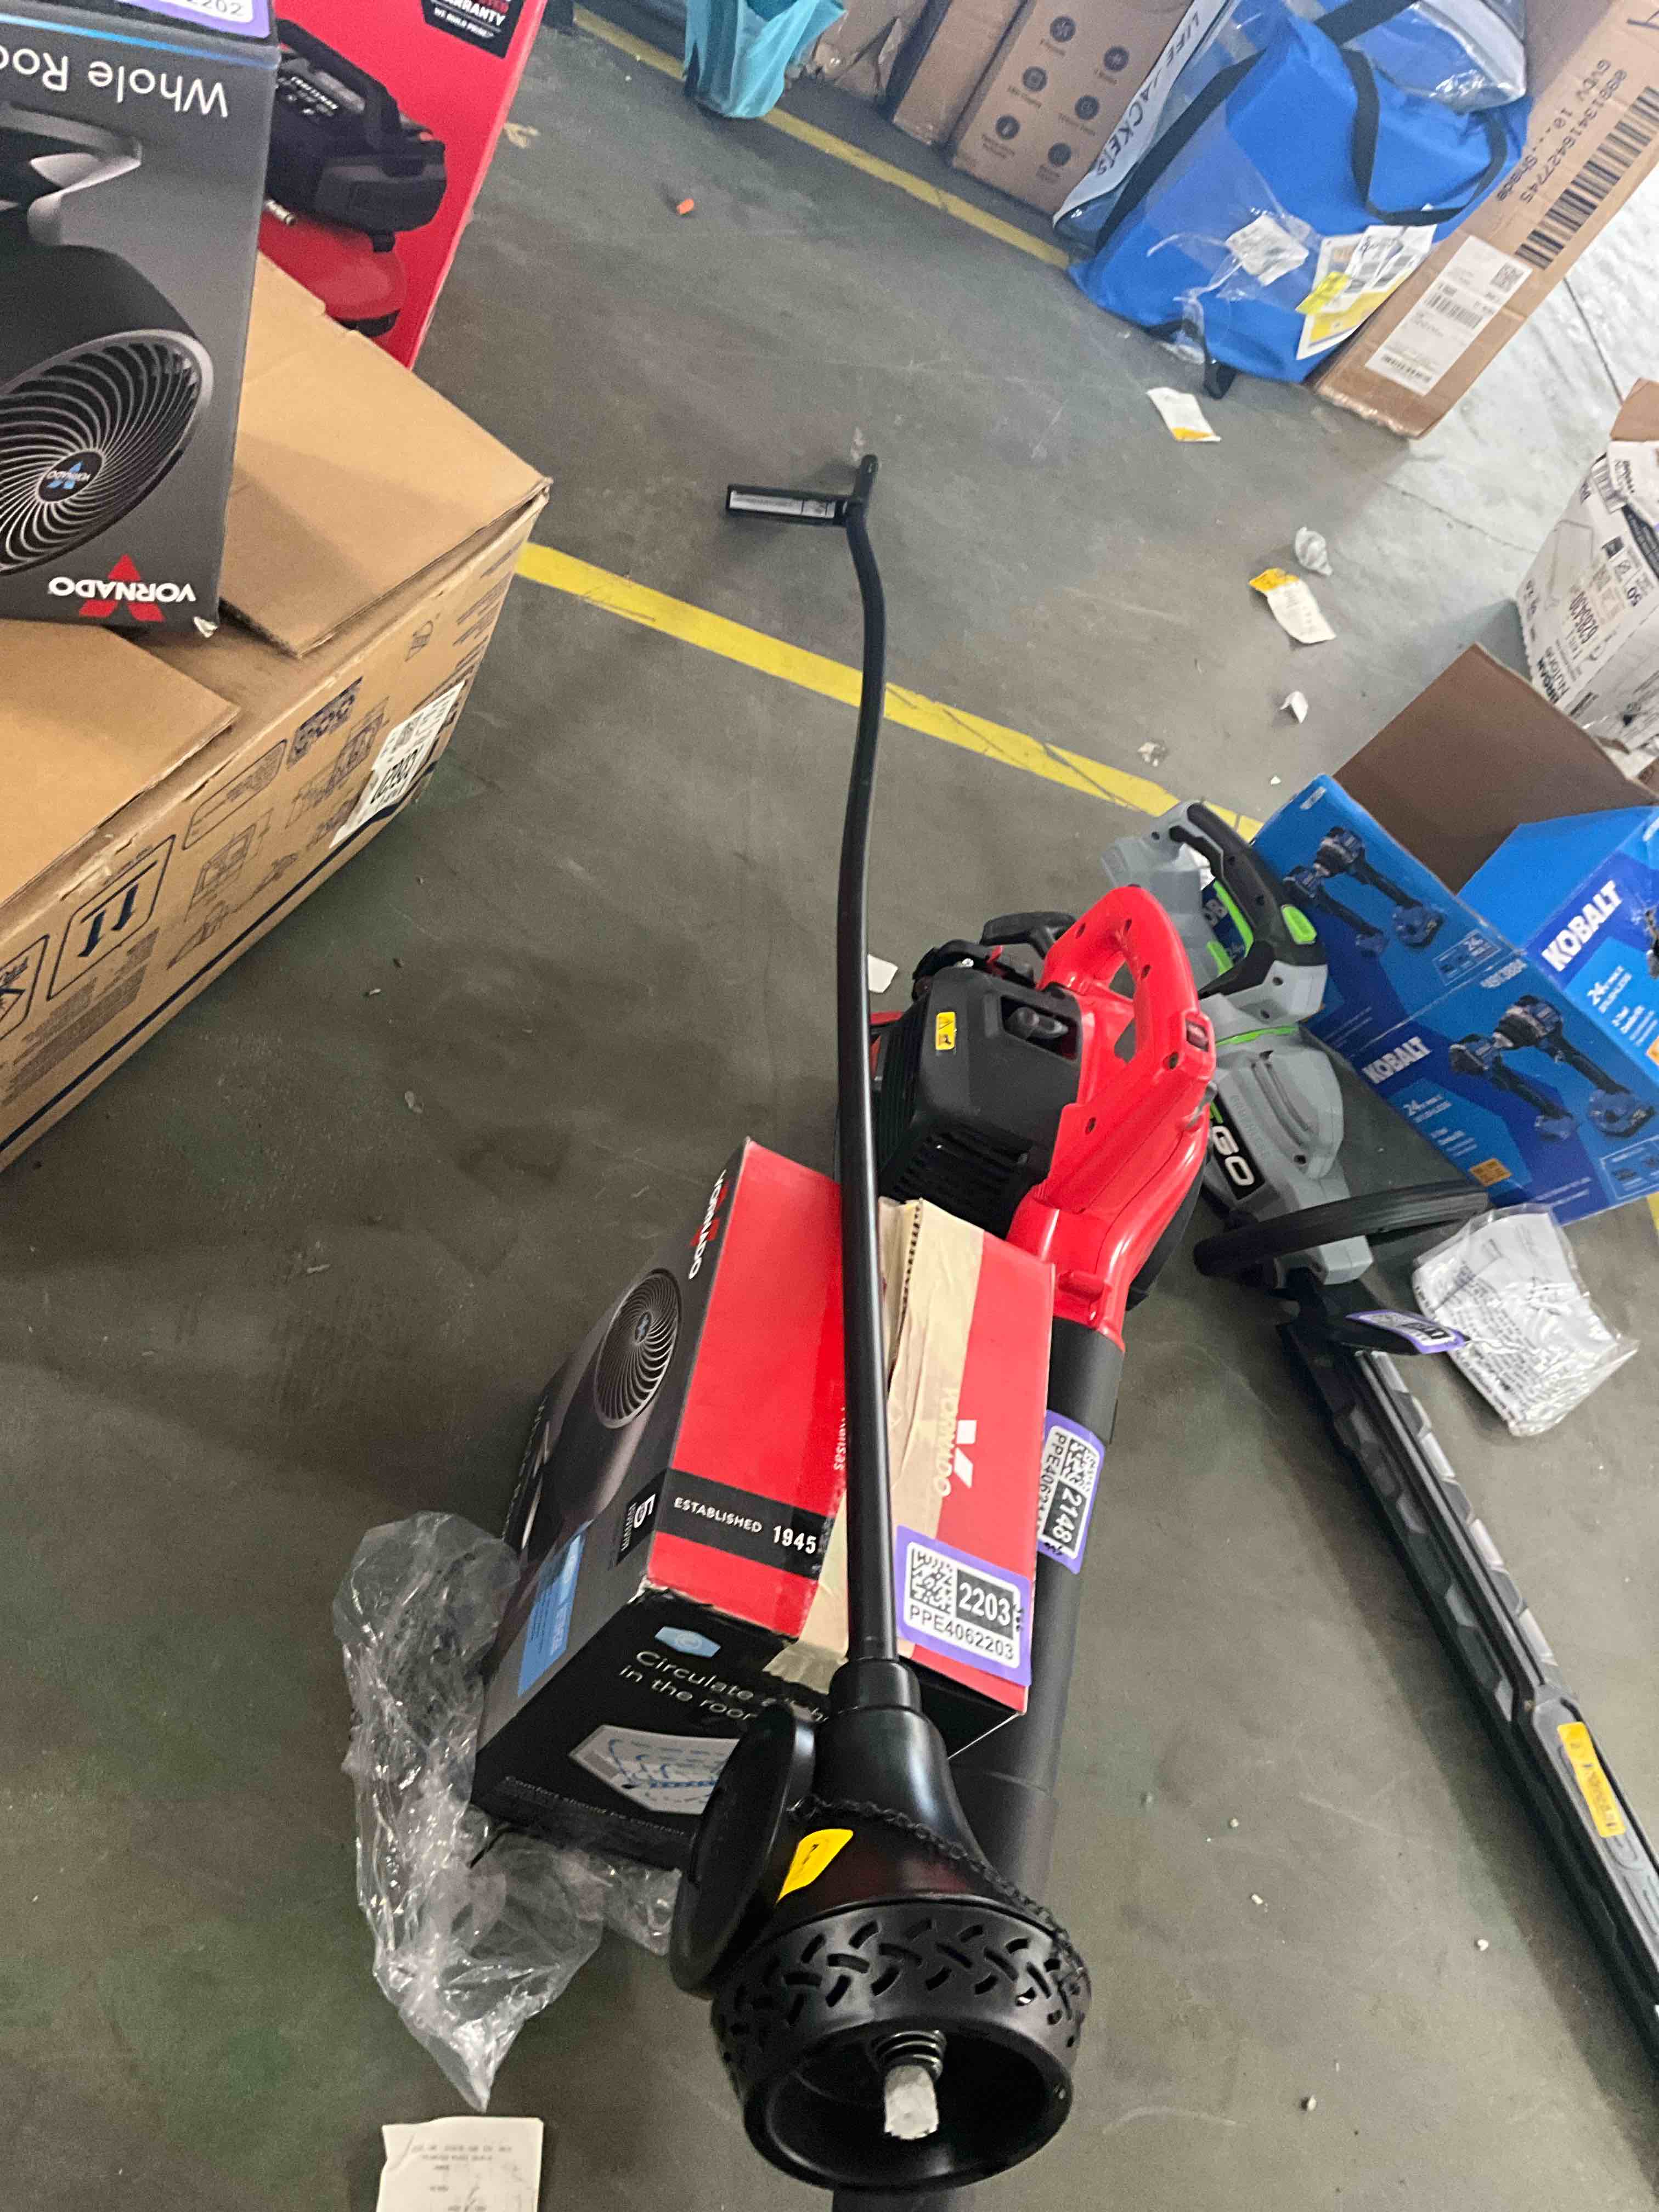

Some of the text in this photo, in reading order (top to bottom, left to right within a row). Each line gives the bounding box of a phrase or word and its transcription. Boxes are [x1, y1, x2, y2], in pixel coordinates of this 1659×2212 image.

[1165, 11, 1200, 66] LIFE
[0, 47, 229, 118] Whole Ro
[1096, 70, 1164, 176] JACKETS
[48, 577, 196, 602] VORNADO
[1541, 879, 1623, 972] KOBALT
[1361, 1036, 1432, 1085] KOBALT
[689, 1169, 728, 1280] VORNADO
[674, 1497, 817, 1554] ESTABLISHED 1945
[1052, 1491, 1085, 1543] 2148
[957, 1580, 1012, 1626] 2203
[909, 1604, 1015, 1661] PPE4062203
[619, 1665, 643, 1683] in
[652, 1679, 693, 1701] the
[636, 1651, 754, 1701] Circulate
